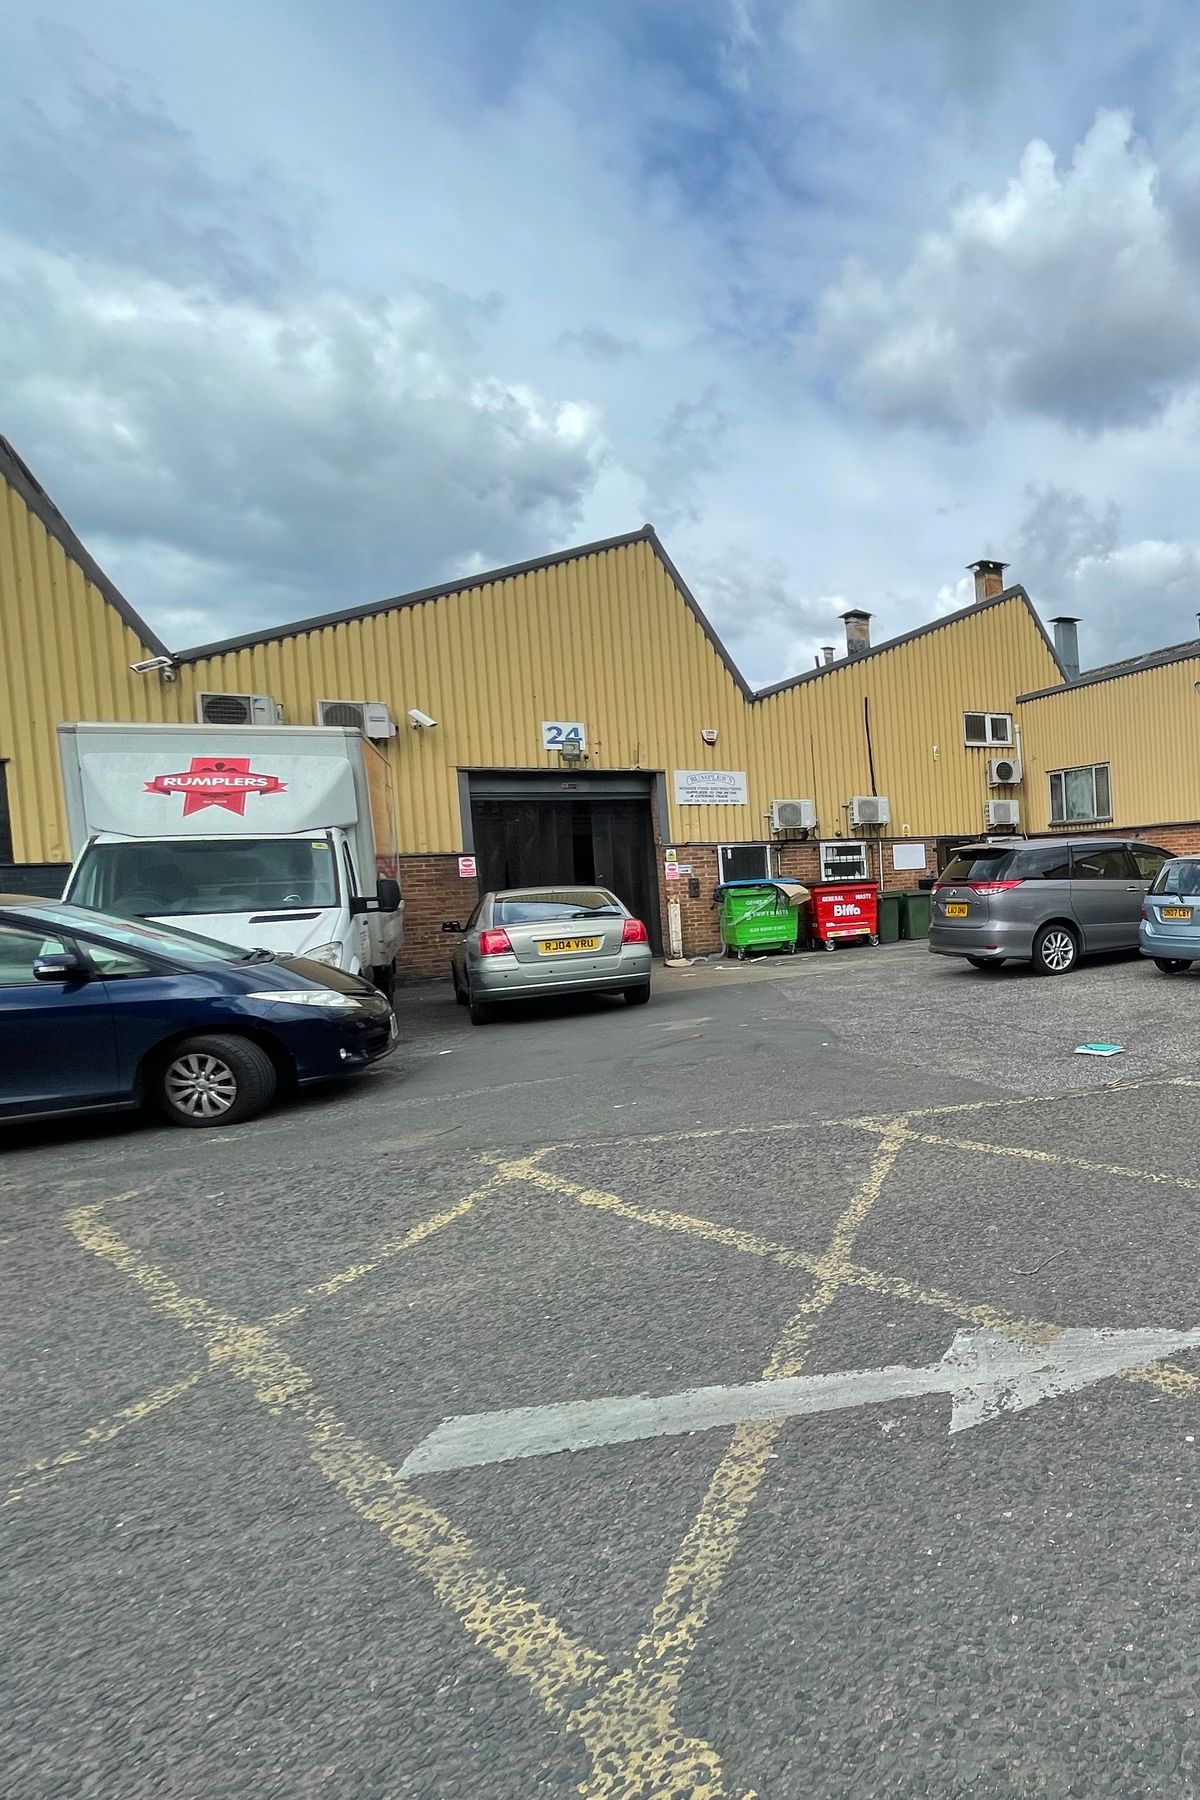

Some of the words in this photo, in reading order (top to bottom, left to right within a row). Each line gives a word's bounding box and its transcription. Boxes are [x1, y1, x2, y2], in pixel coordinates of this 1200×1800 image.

[546, 726, 582, 744] 24
[164, 777, 268, 786] RUMPLERS
[834, 904, 861, 917] Biffa
[545, 941, 571, 950] RJ04
[575, 939, 593, 948] VRU
